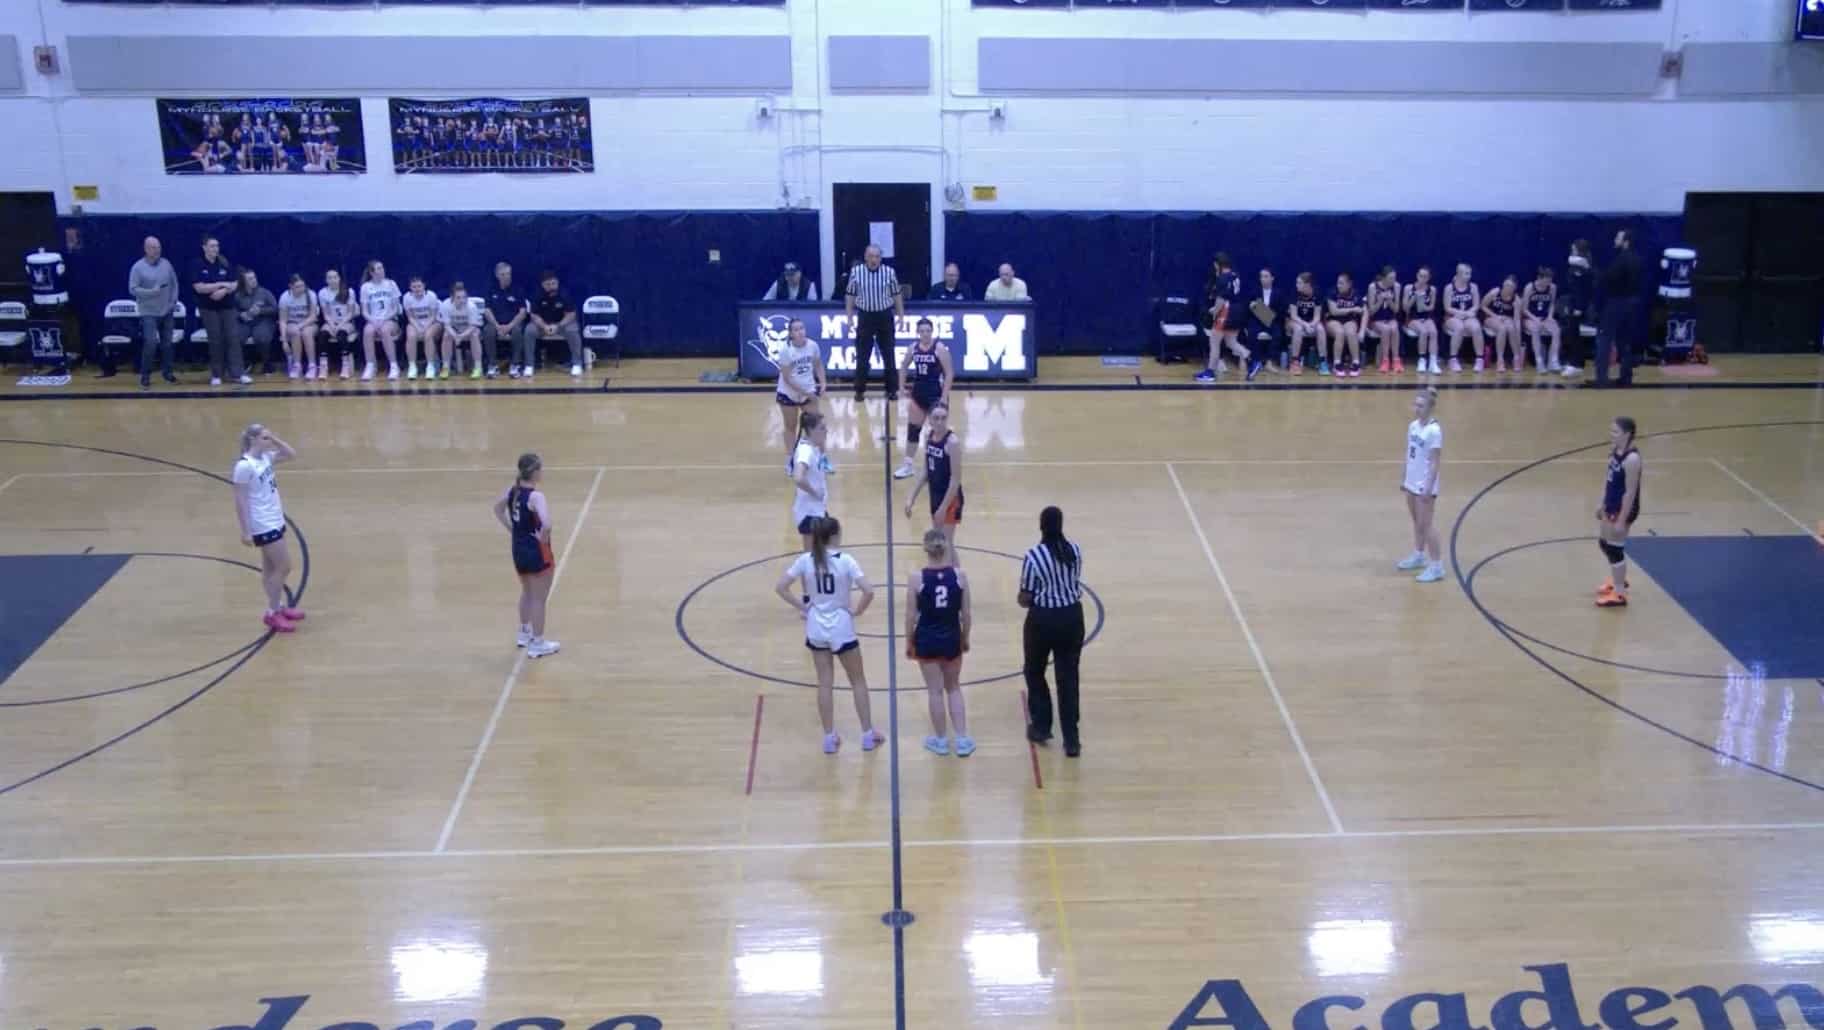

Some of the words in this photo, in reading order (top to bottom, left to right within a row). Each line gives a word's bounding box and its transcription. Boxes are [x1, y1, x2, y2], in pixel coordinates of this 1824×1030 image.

[962, 313, 1027, 371] M
[918, 363, 928, 375] 12
[815, 573, 836, 594] 10
[934, 585, 948, 608] 2
